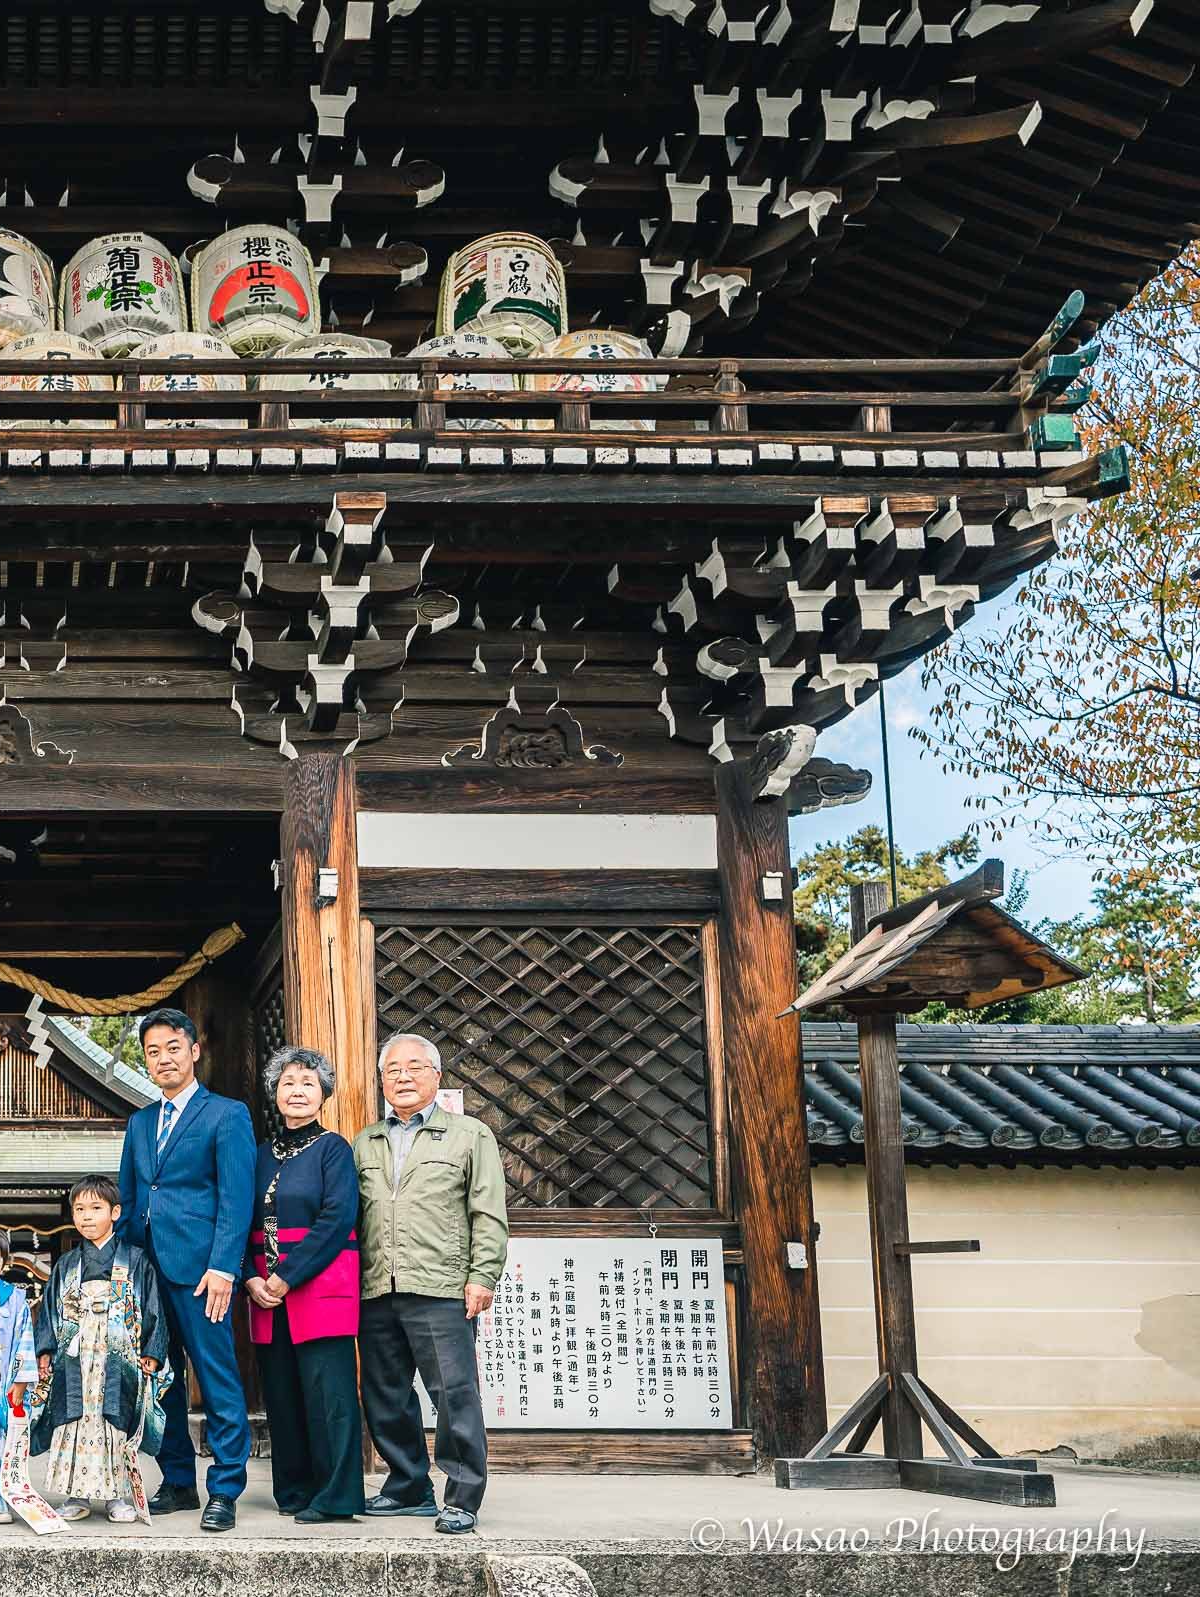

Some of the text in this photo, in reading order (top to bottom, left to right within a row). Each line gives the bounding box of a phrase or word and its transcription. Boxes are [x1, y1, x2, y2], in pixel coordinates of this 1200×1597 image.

[106, 247, 143, 312] 菊正宗
[240, 237, 277, 307] 櫻正宗
[507, 253, 532, 295] 白鶴
[660, 1249, 679, 1290] 閉門
[691, 1249, 709, 1290] 開門
[549, 1278, 564, 1409] 午前九時より午後五時
[673, 1299, 687, 1377] 夏期午後六時
[690, 1299, 704, 1377] 冬期午前七時
